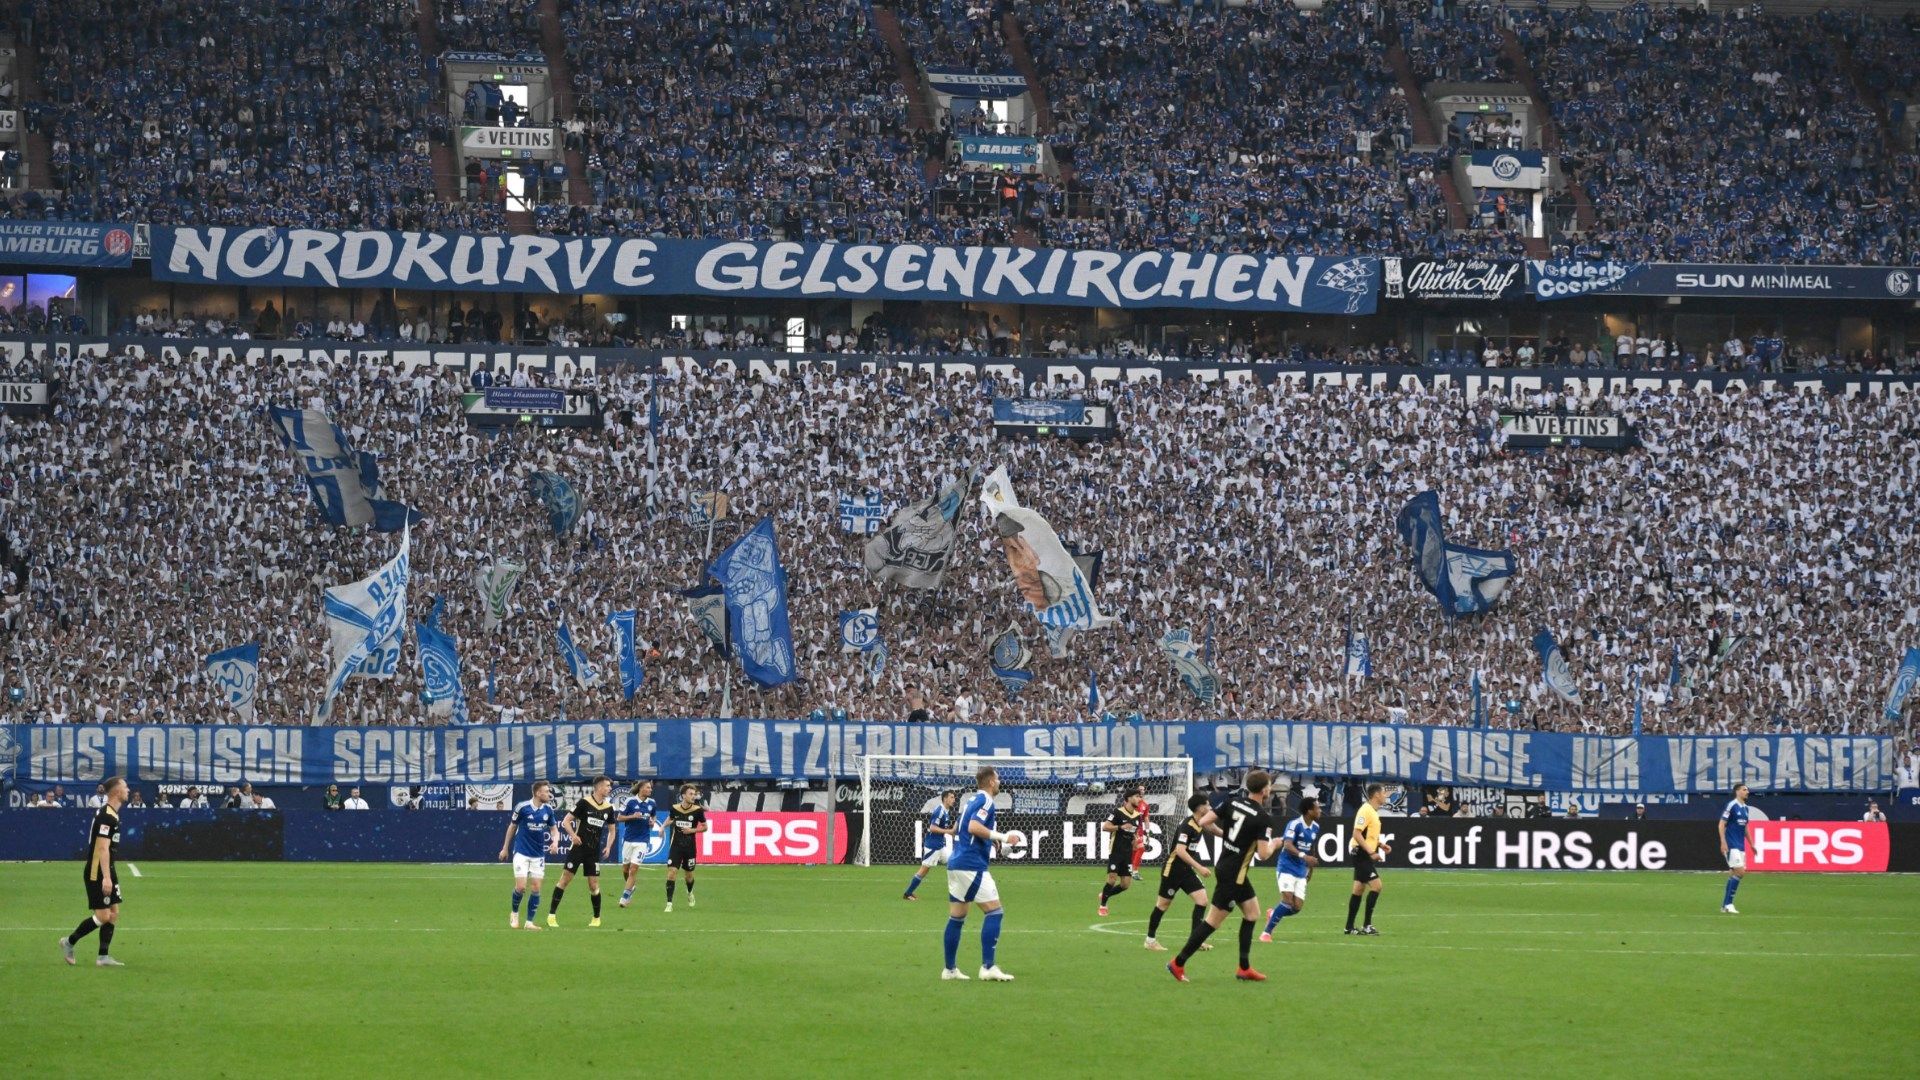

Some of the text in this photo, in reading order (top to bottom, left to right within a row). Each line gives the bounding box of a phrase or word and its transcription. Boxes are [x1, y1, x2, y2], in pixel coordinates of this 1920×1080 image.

[489, 131, 550, 147] VELTINS
[978, 144, 1021, 155] RADE
[46, 226, 100, 236] FILIALE
[168, 227, 658, 294] NORDKURVE
[695, 242, 1316, 307] GELSENKIRCHEN
[1676, 273, 1832, 289] SUN MINIMEAL
[1535, 417, 1609, 435] VELTINS
[31, 727, 303, 782] HISTORISCH
[334, 720, 657, 783] SCHLECHTESTE
[690, 720, 978, 778] PLATZIERUNG
[1023, 720, 1185, 776] SCHÖNE
[1570, 737, 1639, 790] IHR
[1668, 737, 1893, 792] VERSAGER!
[703, 820, 820, 856] HRS
[1228, 810, 1246, 842] 7
[1408, 825, 1483, 865] auf
[1496, 831, 1667, 869] HRS.de
[1754, 828, 1864, 864] HRS
